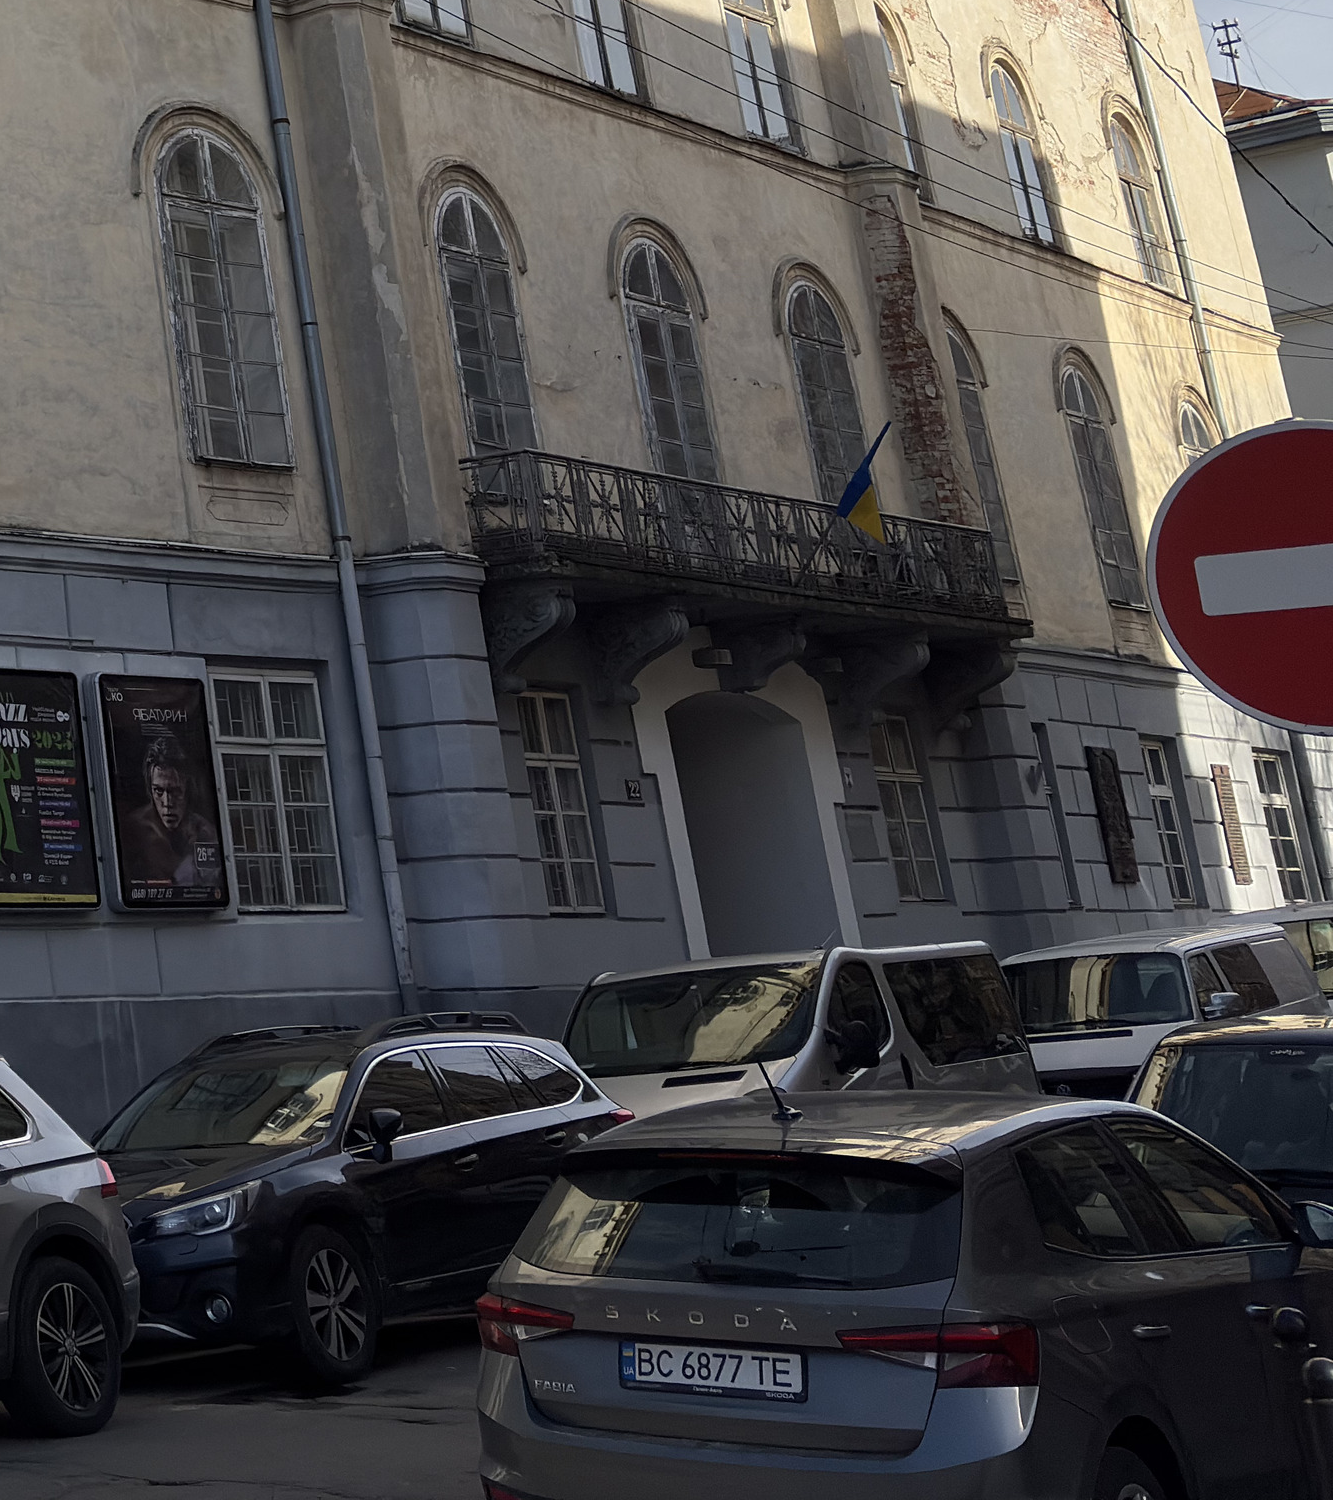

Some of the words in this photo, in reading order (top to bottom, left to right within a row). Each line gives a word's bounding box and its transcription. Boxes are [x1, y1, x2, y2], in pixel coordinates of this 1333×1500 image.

[628, 781, 640, 797] 22
[196, 847, 207, 862] 26
[623, 1366, 634, 1376] UA
[637, 1347, 674, 1378] BC
[681, 1351, 743, 1383] 6877
[751, 1356, 792, 1388] TE
[534, 1379, 576, 1393] FABIA
